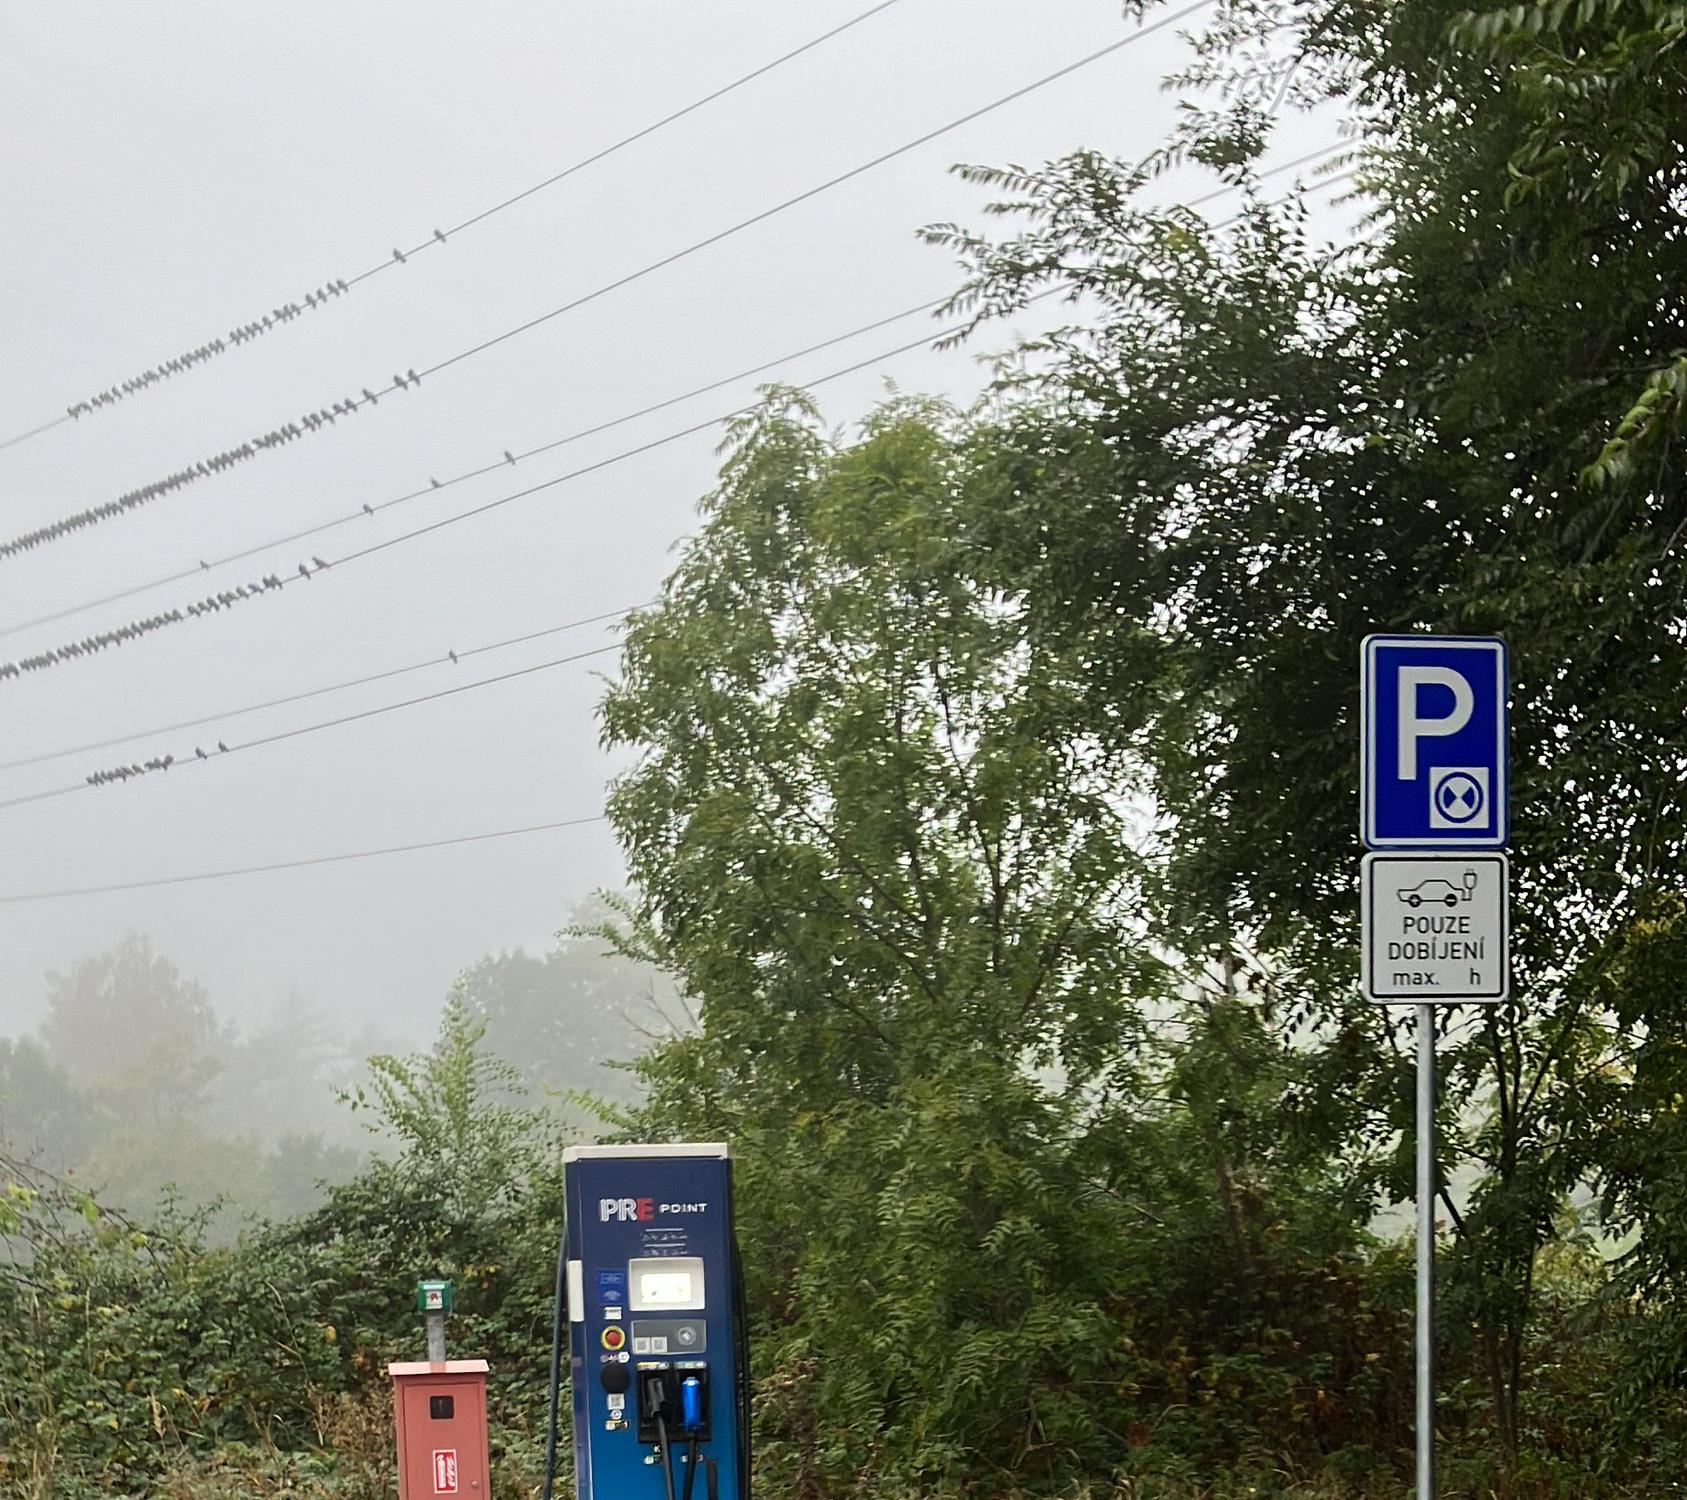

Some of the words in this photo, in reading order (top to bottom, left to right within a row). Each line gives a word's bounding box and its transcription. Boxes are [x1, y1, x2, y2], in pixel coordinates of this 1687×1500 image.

[1398, 666, 1474, 780] P
[1403, 916, 1470, 934] POUZE
[1389, 936, 1485, 960] DOBÍJENÍ
[1393, 972, 1440, 986] max.
[1469, 967, 1481, 985] h
[600, 1198, 654, 1222] PRE
[659, 1203, 707, 1214] POINT
